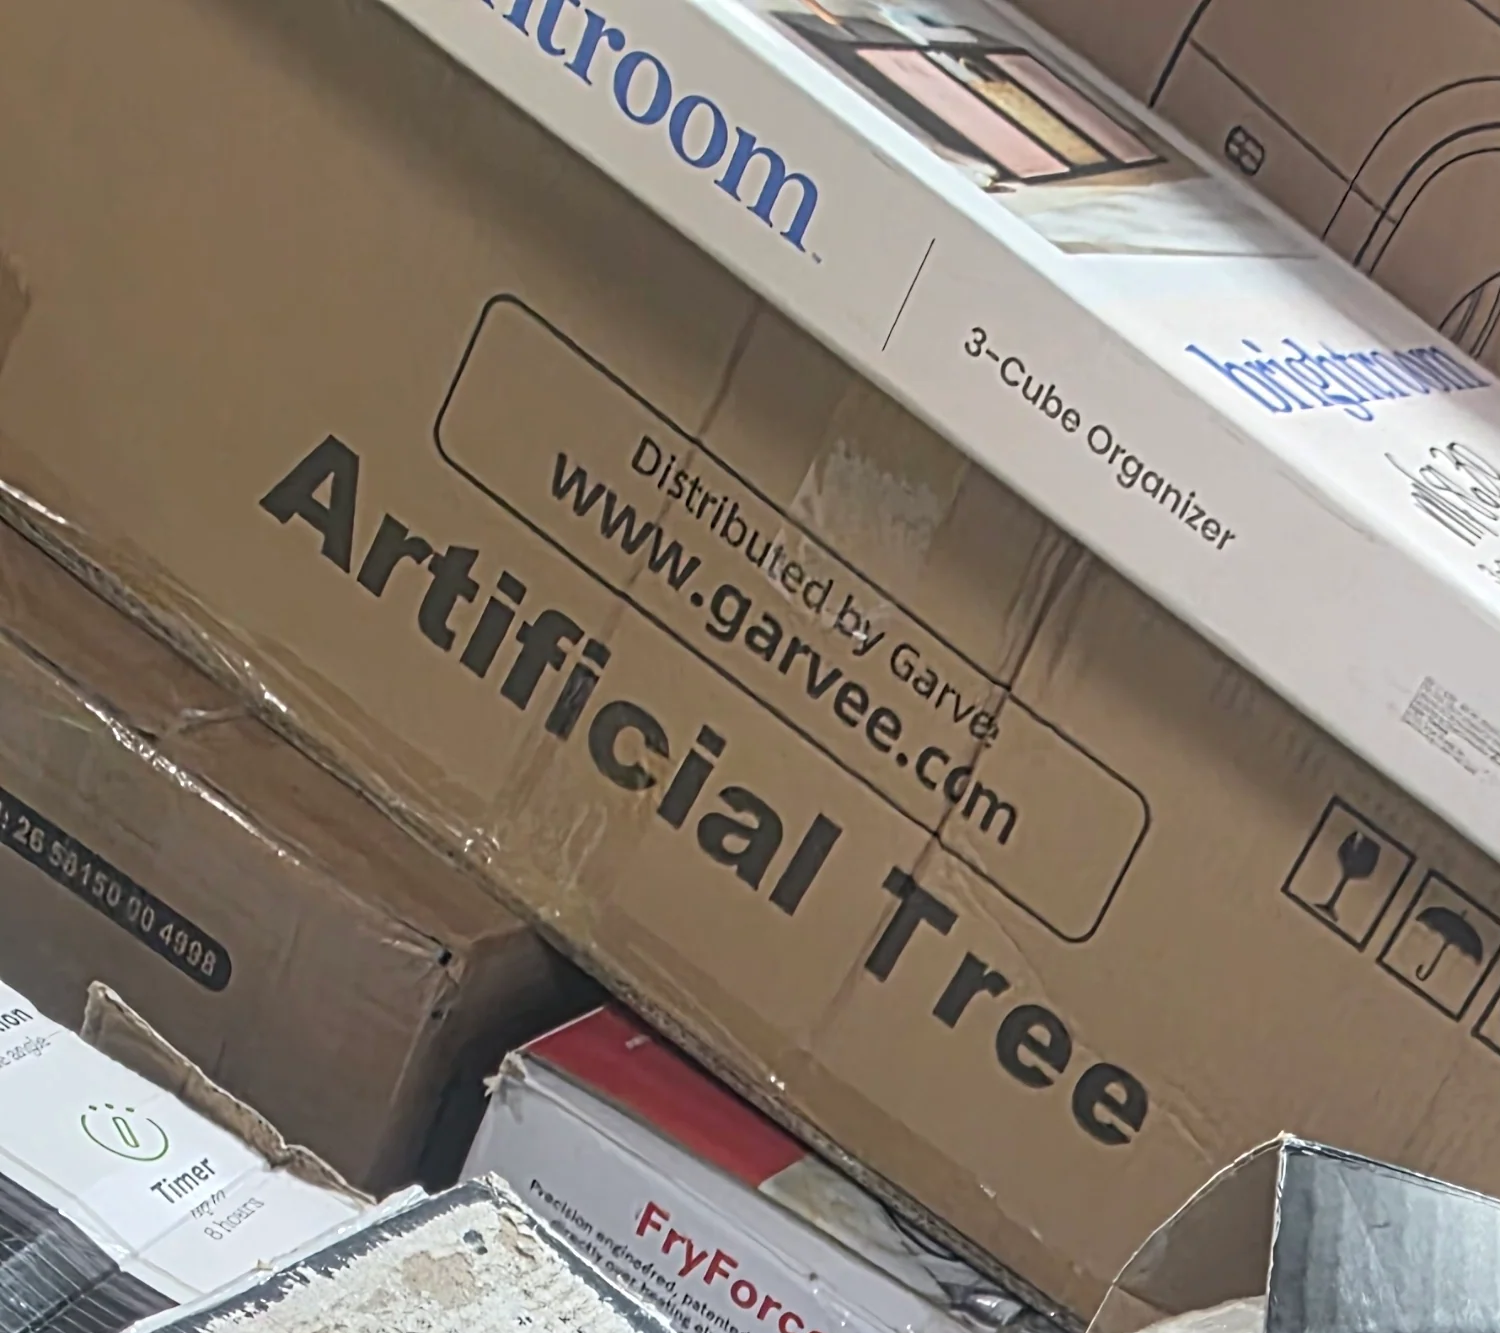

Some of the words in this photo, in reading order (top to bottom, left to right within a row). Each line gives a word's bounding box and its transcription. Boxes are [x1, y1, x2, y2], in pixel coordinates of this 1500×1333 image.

[631, 435, 834, 614] Distributed
[833, 594, 885, 656] by
[964, 327, 1080, 433] 3-Cube
[1087, 425, 1235, 550] Organizer
[550, 453, 1018, 845] www.garvee.com
[259, 434, 843, 916] Artificial
[863, 866, 1150, 1147] Tree
[150, 1158, 216, 1205] Timer
